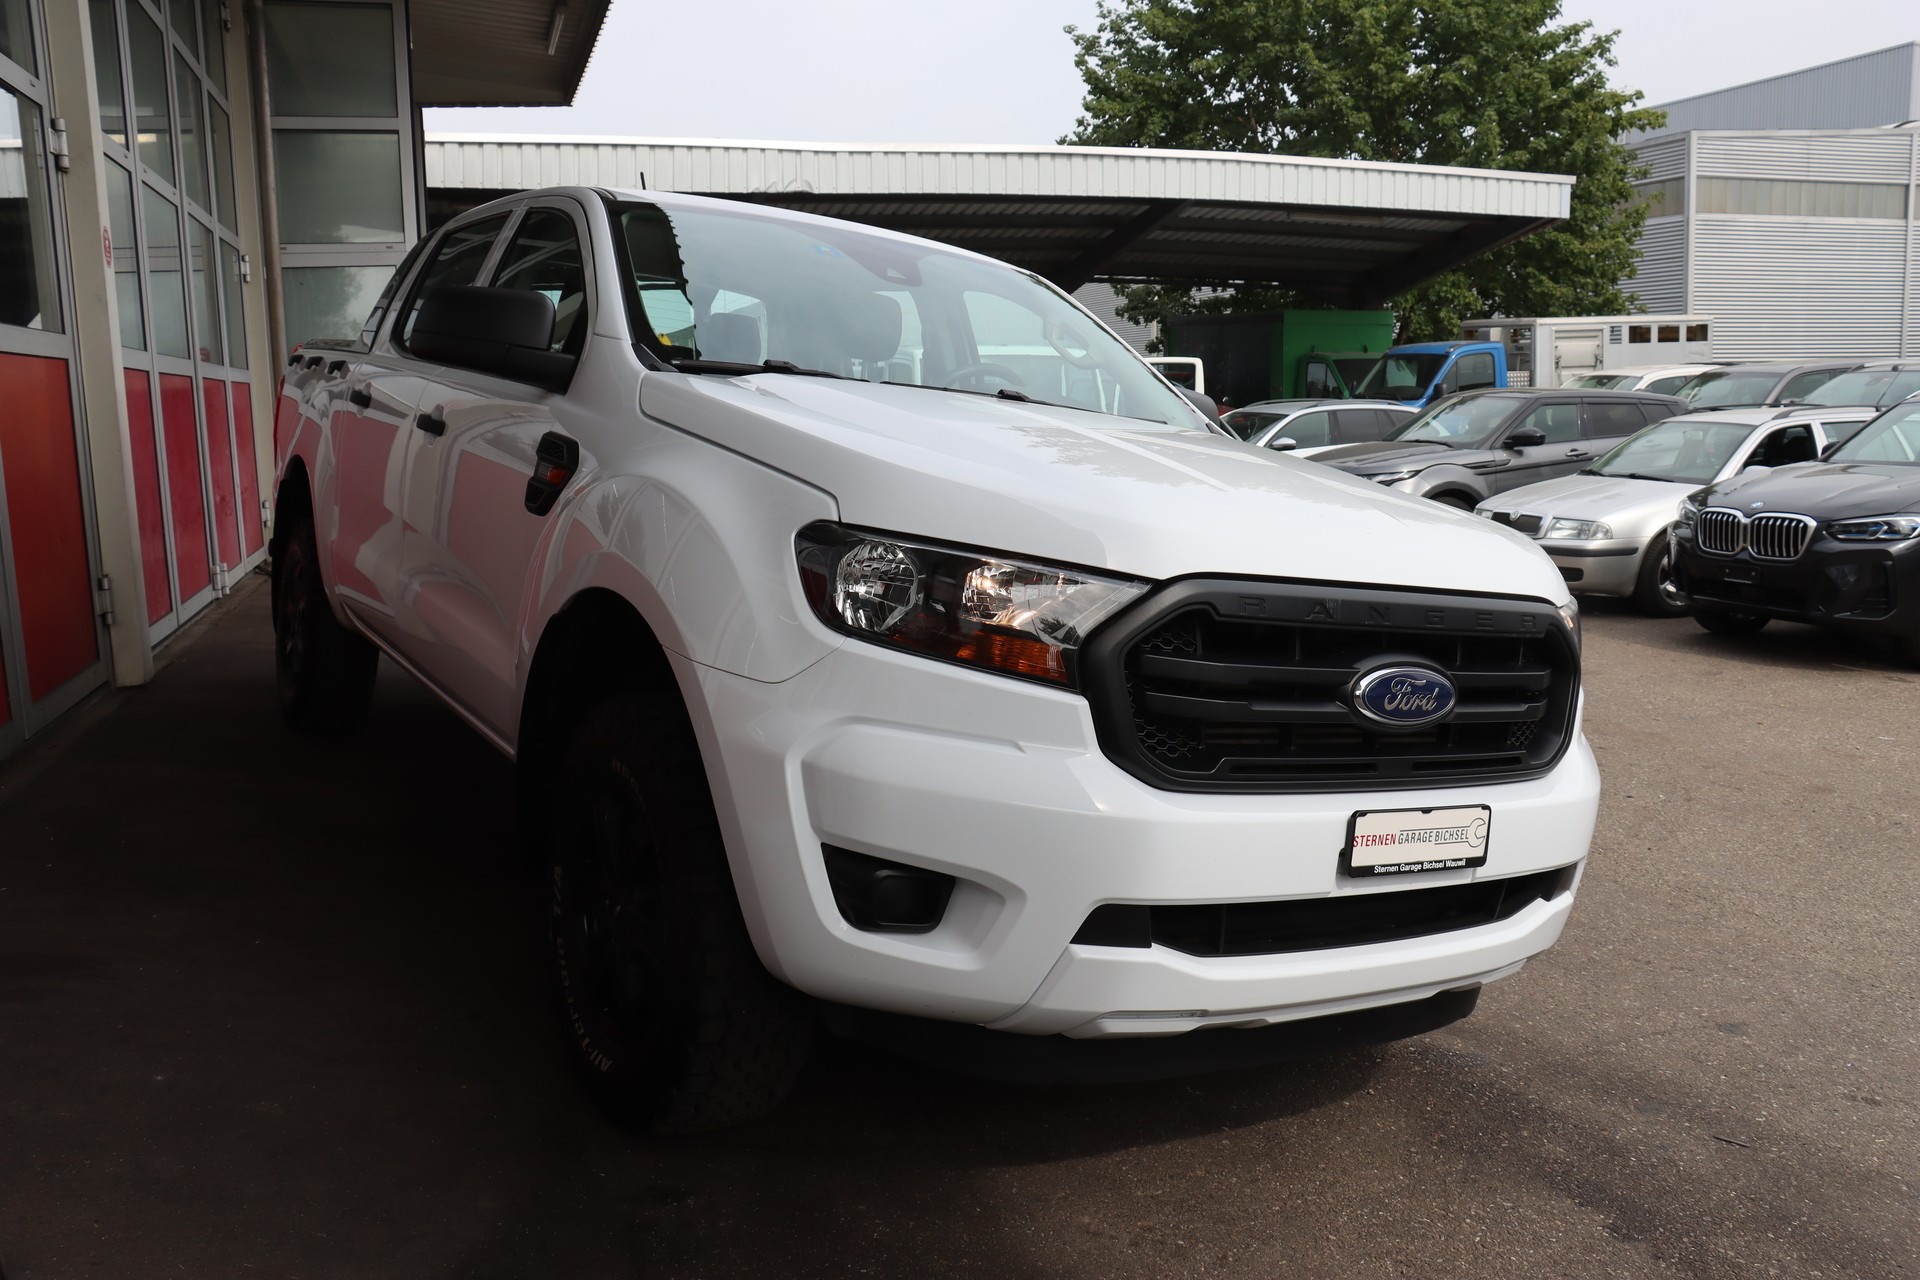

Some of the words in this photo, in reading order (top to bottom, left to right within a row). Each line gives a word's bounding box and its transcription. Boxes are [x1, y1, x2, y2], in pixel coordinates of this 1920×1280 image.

[1239, 596, 1538, 632] RANGER
[1383, 677, 1439, 713] Ford
[1353, 833, 1397, 848] STERNEN
[1398, 830, 1433, 845] GARAGE
[1434, 828, 1469, 842] BICHSEL
[1374, 864, 1399, 874] Sternen
[1400, 862, 1422, 873] Garage
[1423, 860, 1445, 870] Bichsel
[1446, 858, 1466, 868] Wauwil
